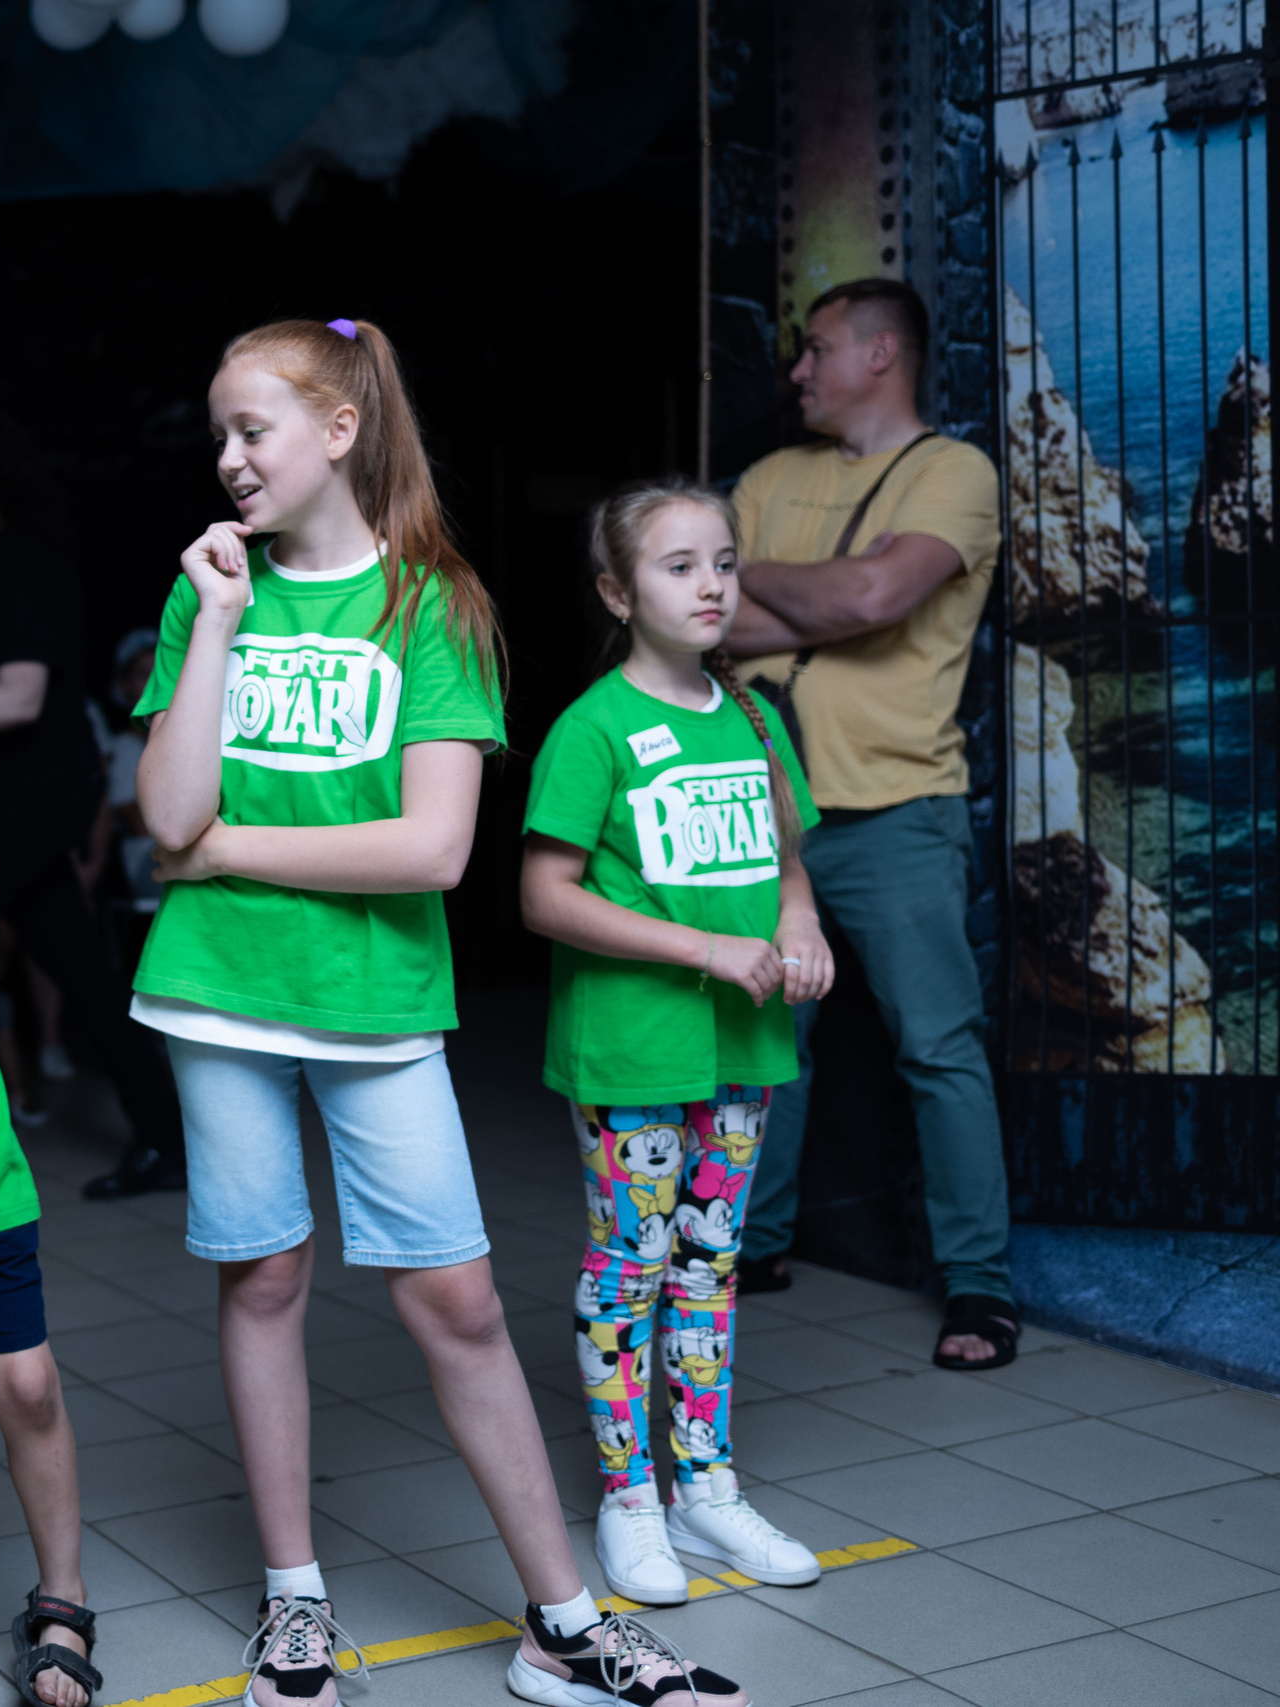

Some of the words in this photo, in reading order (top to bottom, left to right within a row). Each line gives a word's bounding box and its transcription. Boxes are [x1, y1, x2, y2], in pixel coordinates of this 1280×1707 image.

[244, 649, 346, 678] FORT
[682, 774, 766, 804] FORT
[627, 784, 779, 884] BOYAR
